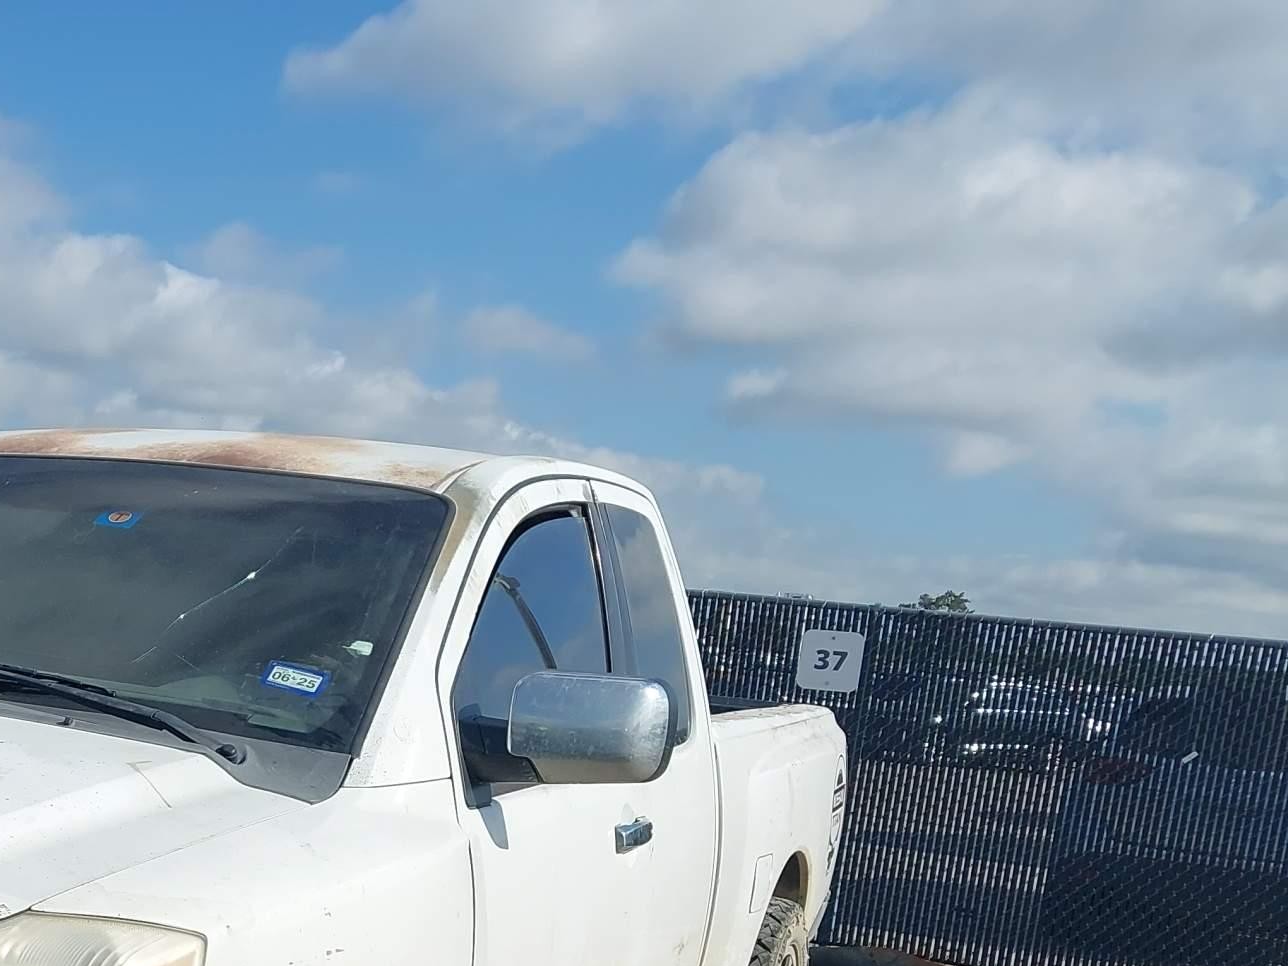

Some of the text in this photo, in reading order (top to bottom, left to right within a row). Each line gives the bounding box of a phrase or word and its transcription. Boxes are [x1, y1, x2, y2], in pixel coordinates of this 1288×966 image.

[814, 650, 848, 671] 37
[271, 671, 316, 689] 06 25
